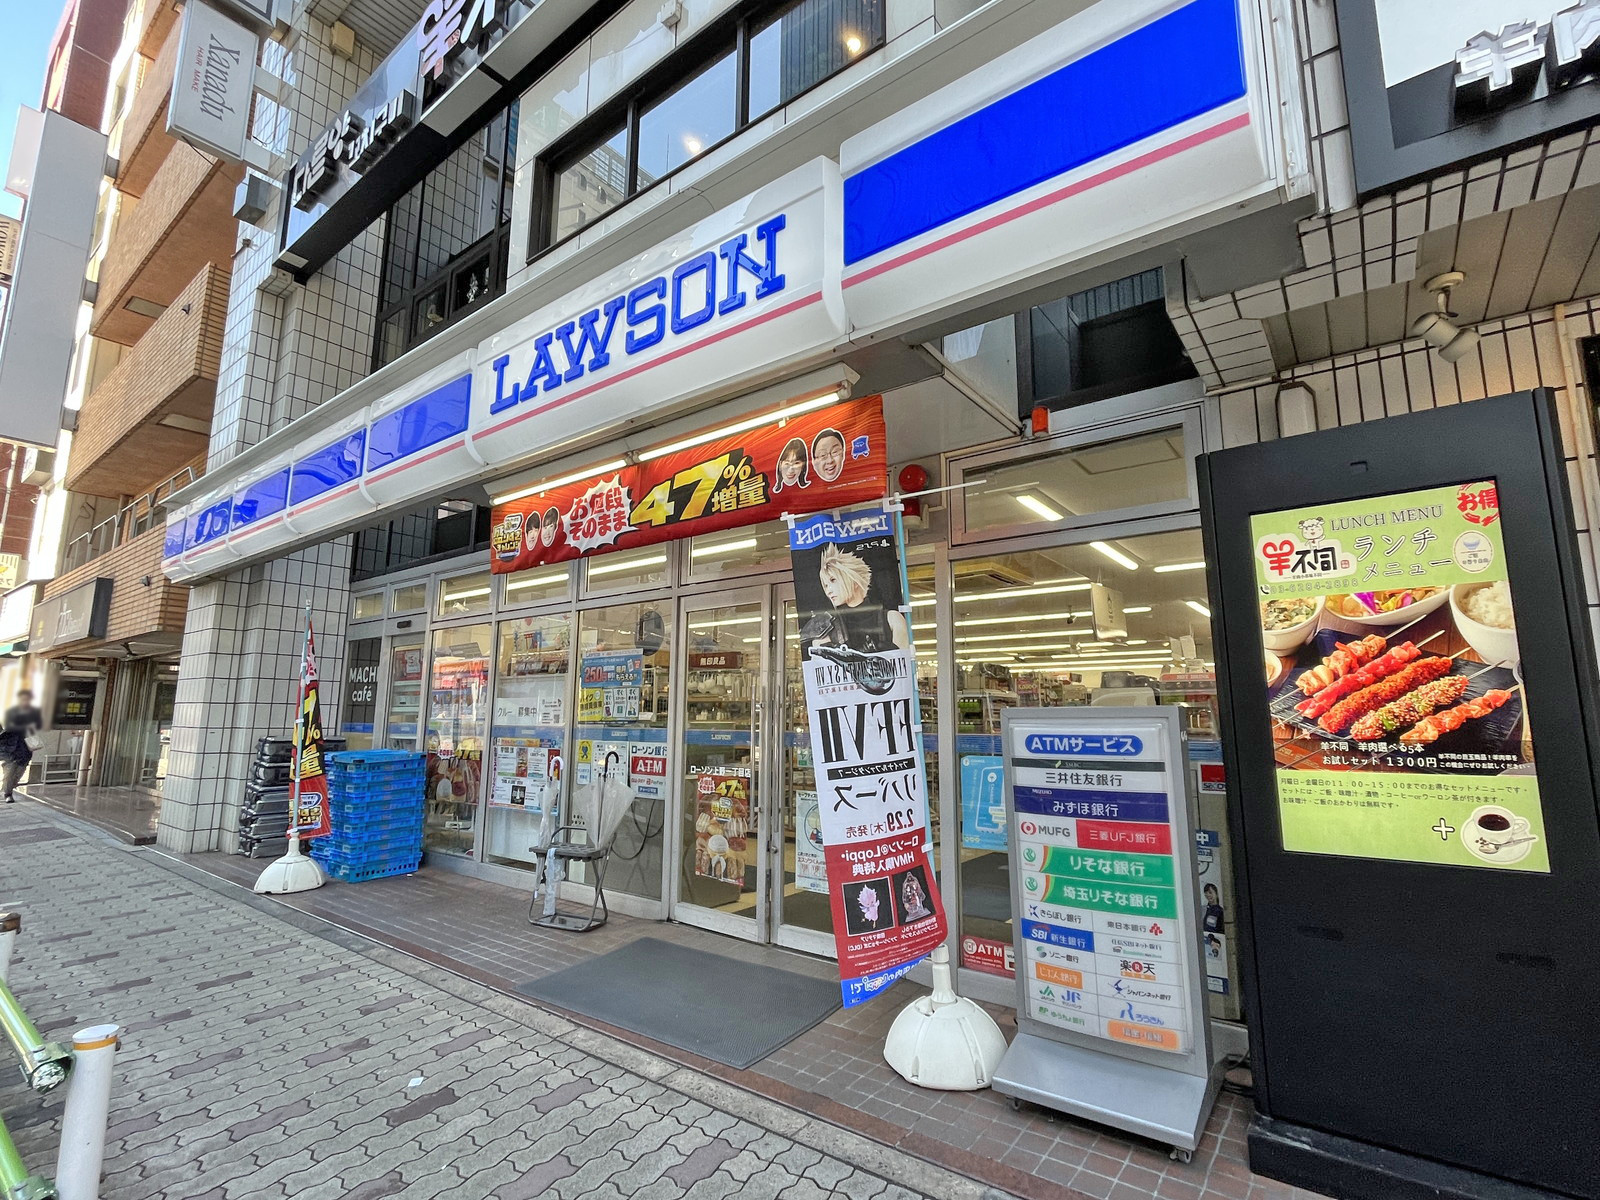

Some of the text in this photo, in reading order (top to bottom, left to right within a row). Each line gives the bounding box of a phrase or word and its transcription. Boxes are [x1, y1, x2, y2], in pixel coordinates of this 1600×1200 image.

[192, 46, 205, 93] HAIR MAKE
[200, 33, 241, 121] Xanadu
[489, 212, 786, 415] LAWSON
[711, 476, 766, 511] 増量
[569, 487, 625, 521] お値段
[569, 511, 628, 541] そのまま
[1331, 505, 1443, 531] LUNCH MENU
[1354, 527, 1438, 562] ランチ
[1262, 539, 1338, 576] 羊不同
[1362, 558, 1453, 582] メニュー
[700, 656, 726, 666] 無印良品
[352, 686, 372, 702] café
[498, 707, 513, 718] クルー
[1031, 736, 1136, 753] ATMサービス
[1320, 741, 1349, 752] 羊不同
[637, 759, 662, 774] ATM
[1322, 755, 1437, 768] お試しセット 1300円
[1045, 772, 1123, 787] 三井住友銀行
[1053, 800, 1119, 817] みずほ銀行
[1038, 825, 1071, 837] MUFG
[1089, 830, 1157, 844] 三菱UFJ銀行
[1070, 855, 1145, 877] りそな銀行
[1063, 885, 1158, 909] 埼玉りそな銀行
[1040, 909, 1082, 924] きらぼし銀行
[1107, 921, 1147, 933] 東日本銀行
[1031, 929, 1086, 948] SBI 新生銀行
[977, 943, 1003, 958] ATM
[1049, 951, 1079, 963] ソニー銀行
[1039, 966, 1079, 984] じぶん銀行
[1127, 988, 1172, 1001] ジャパンネット銀行
[1050, 1011, 1085, 1026] ゆうちょ銀行
[1135, 1014, 1165, 1025] ろうきん
